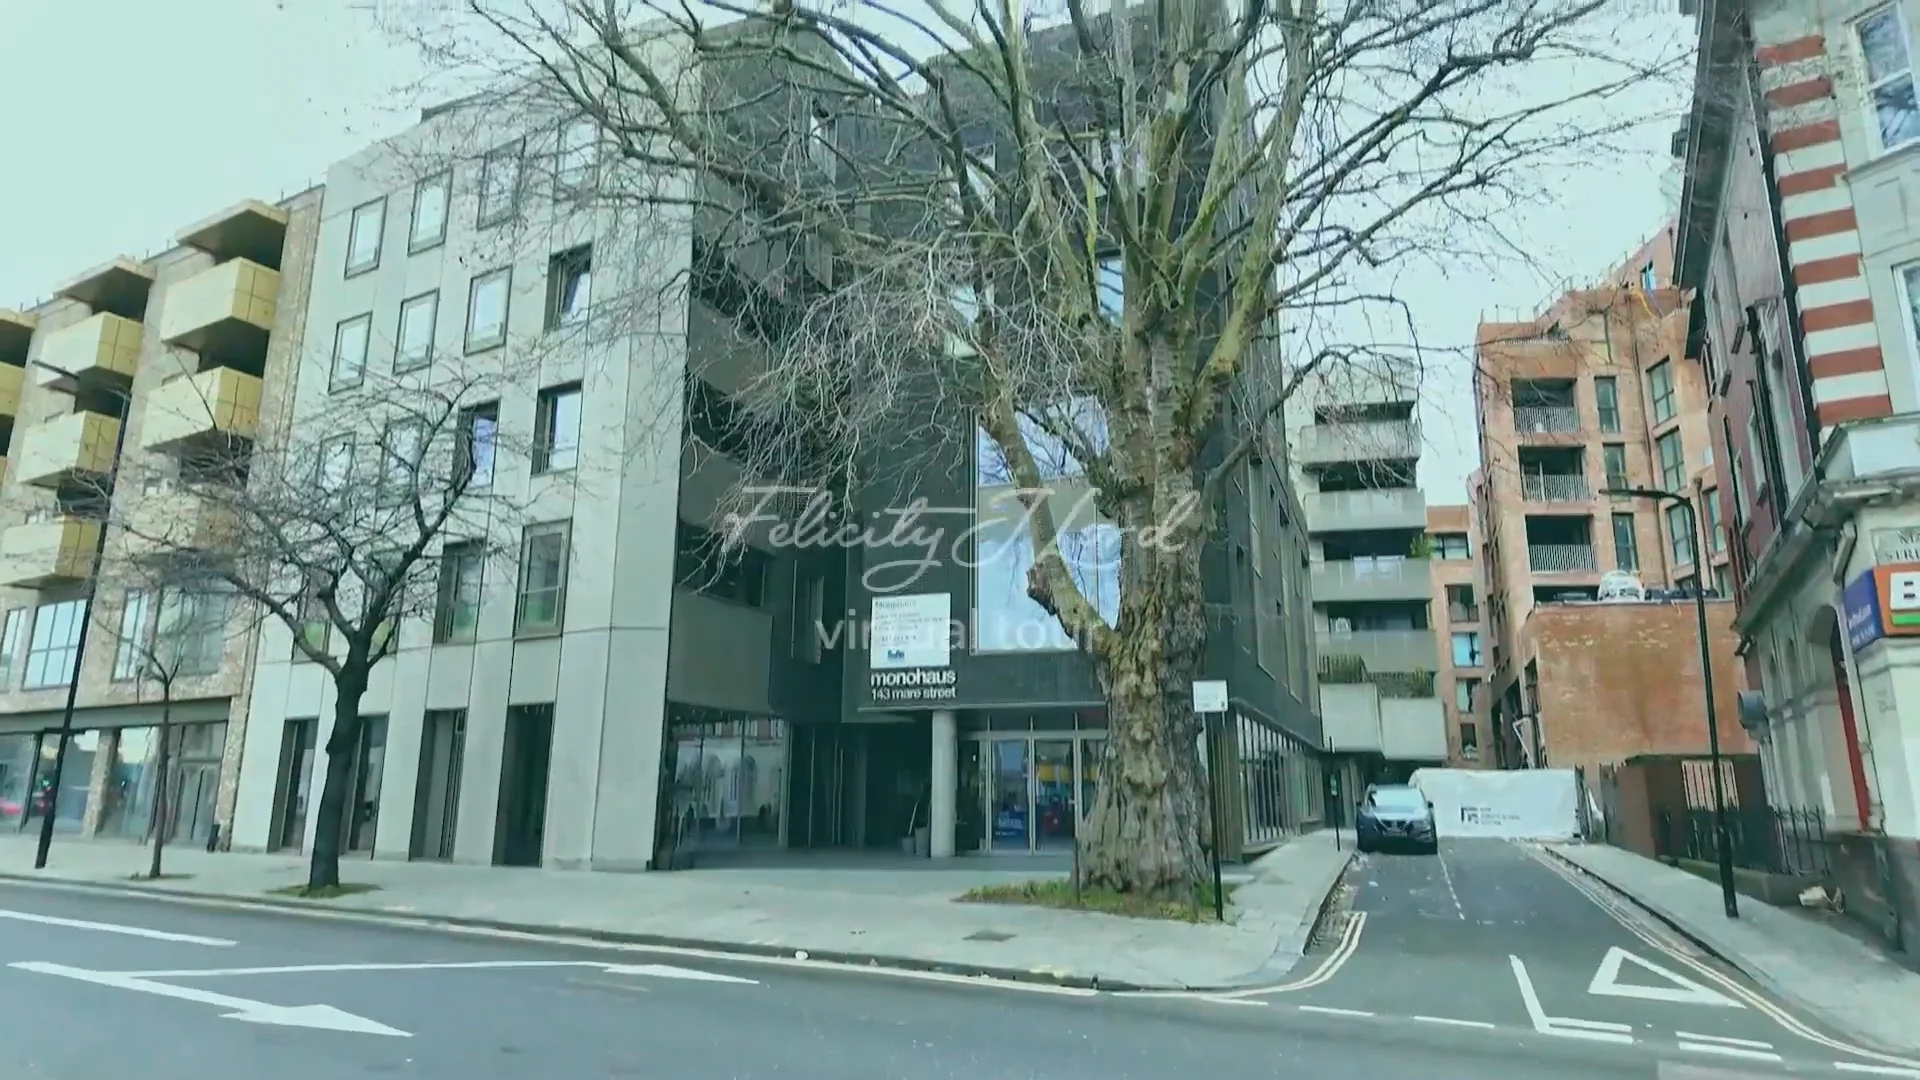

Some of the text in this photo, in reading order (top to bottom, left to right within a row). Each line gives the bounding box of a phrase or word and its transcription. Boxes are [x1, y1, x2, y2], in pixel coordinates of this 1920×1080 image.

[870, 667, 956, 686] monohaus
[872, 685, 956, 701] 143 mare street
